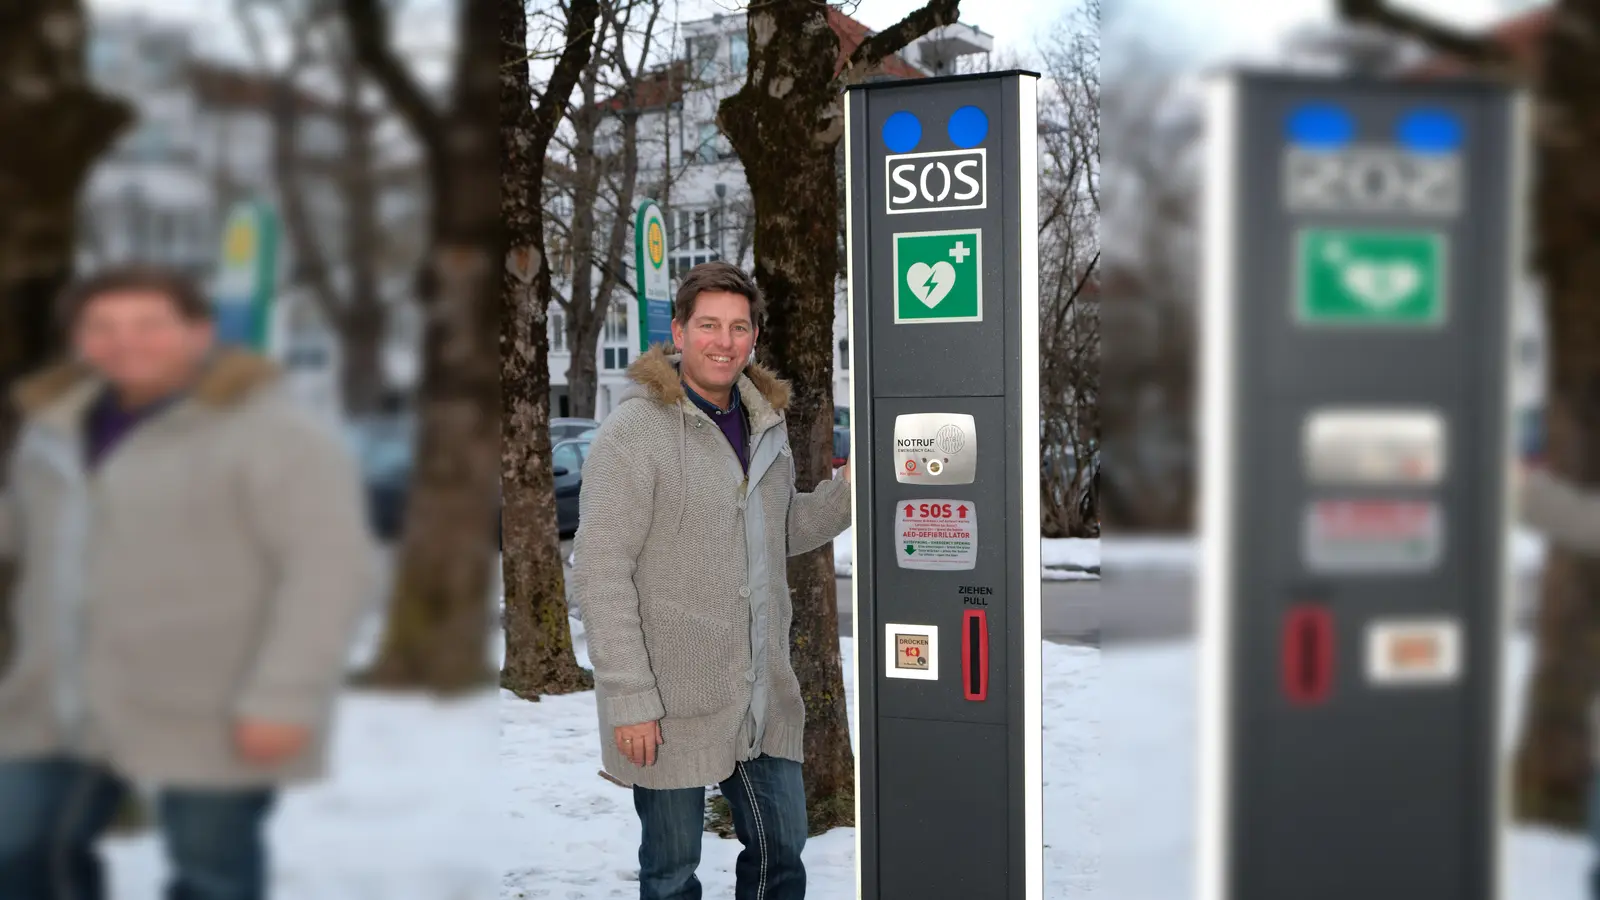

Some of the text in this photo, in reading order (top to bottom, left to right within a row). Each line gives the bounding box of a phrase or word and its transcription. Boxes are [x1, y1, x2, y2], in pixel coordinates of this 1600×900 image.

[892, 160, 980, 204] SOS
[897, 438, 935, 447] NOTRUF
[919, 503, 952, 518] SOS
[903, 531, 970, 539] AED-DEFIBRILLATOR
[958, 586, 993, 595] ZIEHEN
[963, 596, 988, 606] PULL
